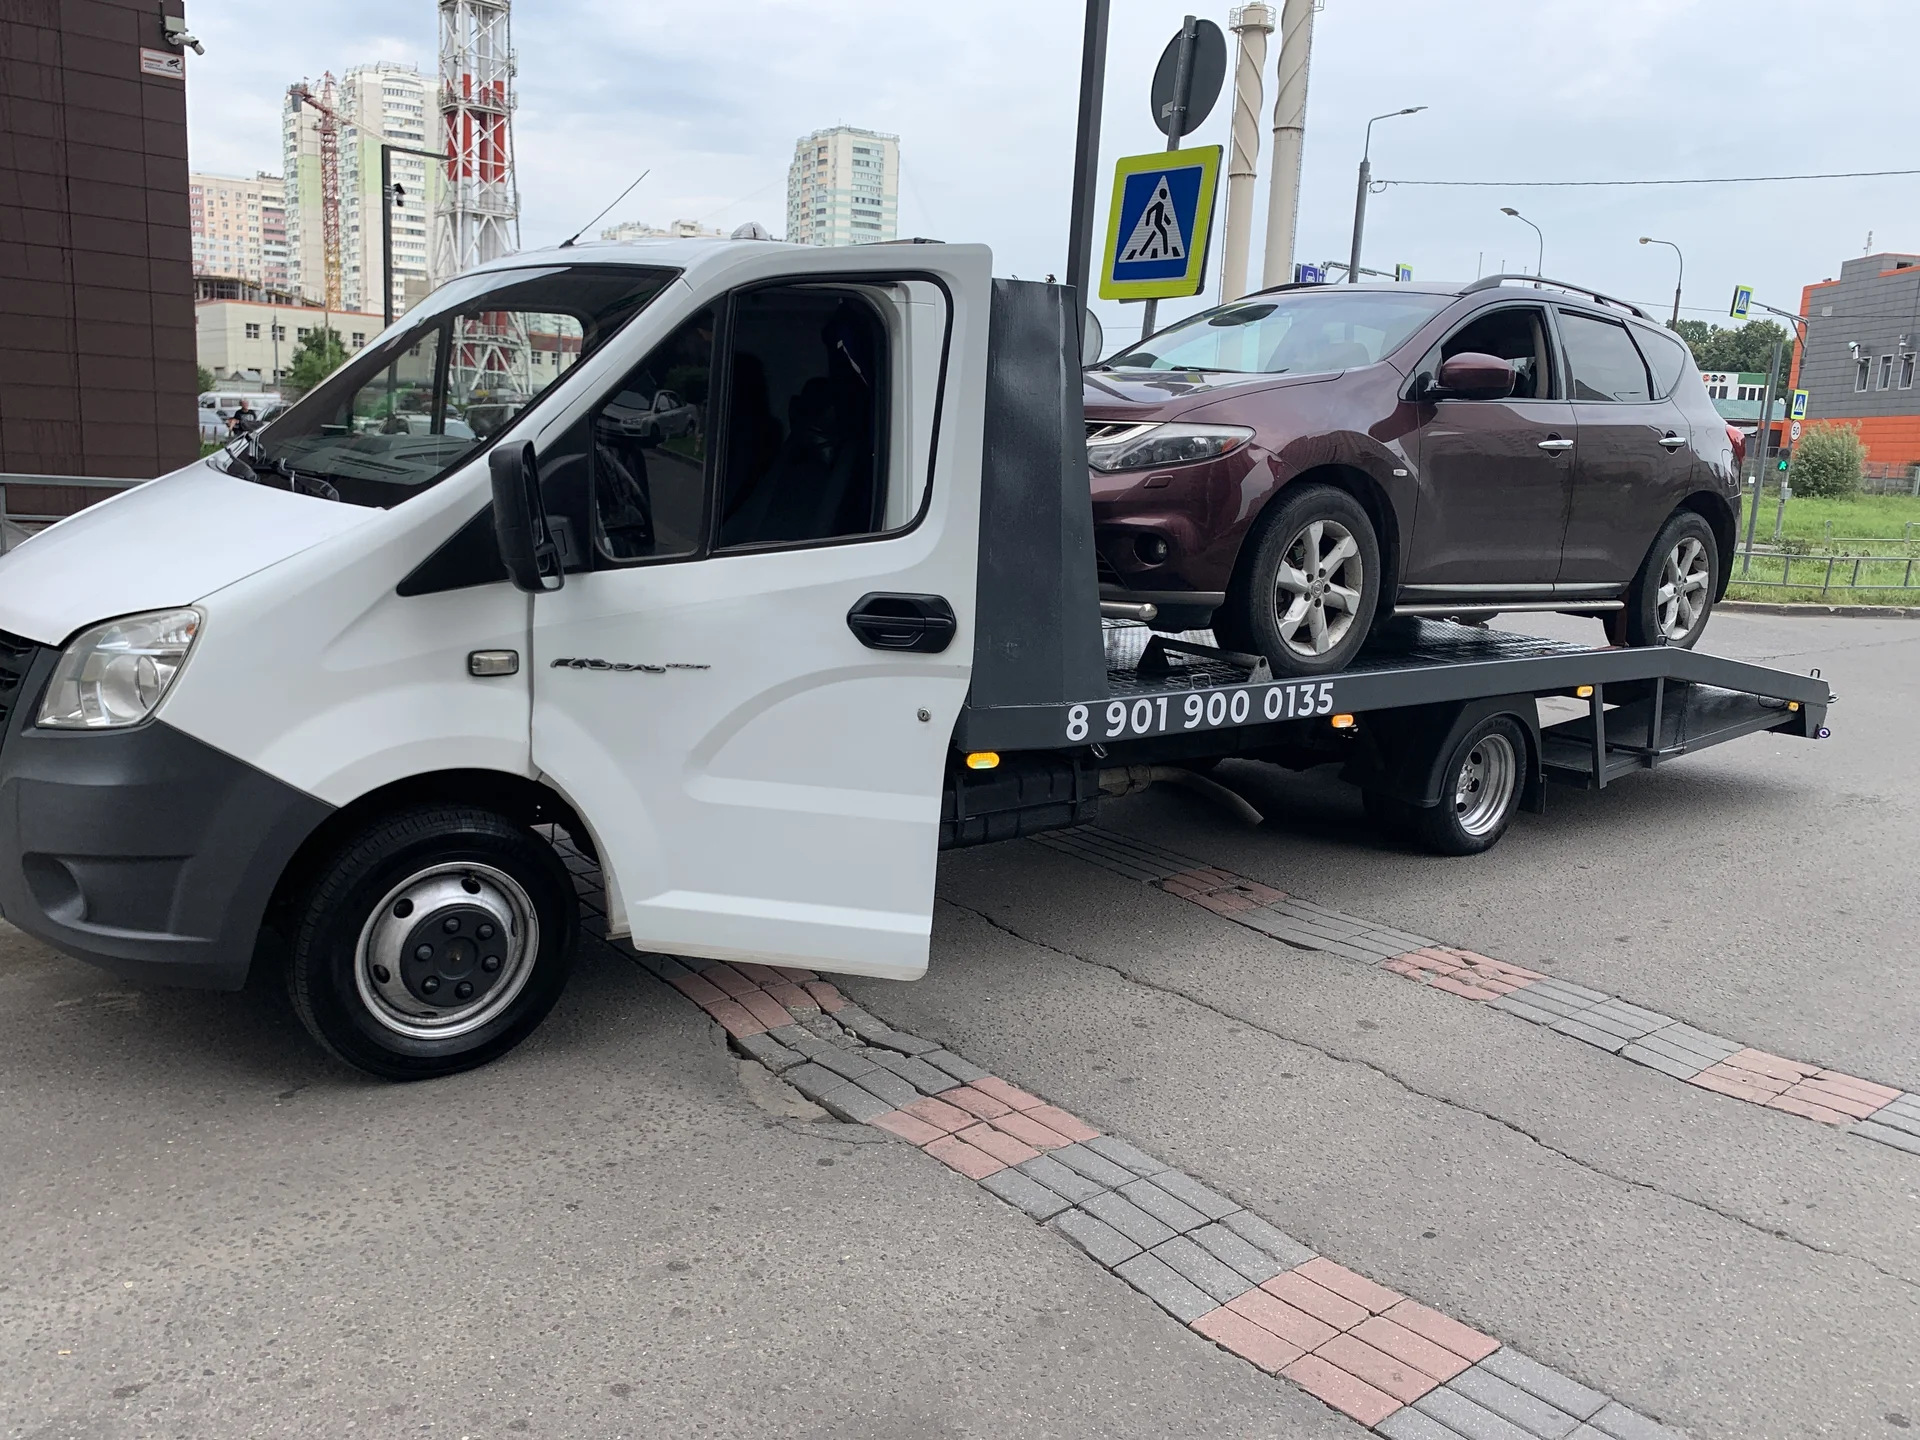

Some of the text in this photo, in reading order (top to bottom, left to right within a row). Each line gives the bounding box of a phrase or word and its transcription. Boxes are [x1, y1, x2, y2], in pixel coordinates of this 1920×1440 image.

[1792, 426, 1800, 436] 50
[1066, 682, 1334, 741] 8 901 900 0135
